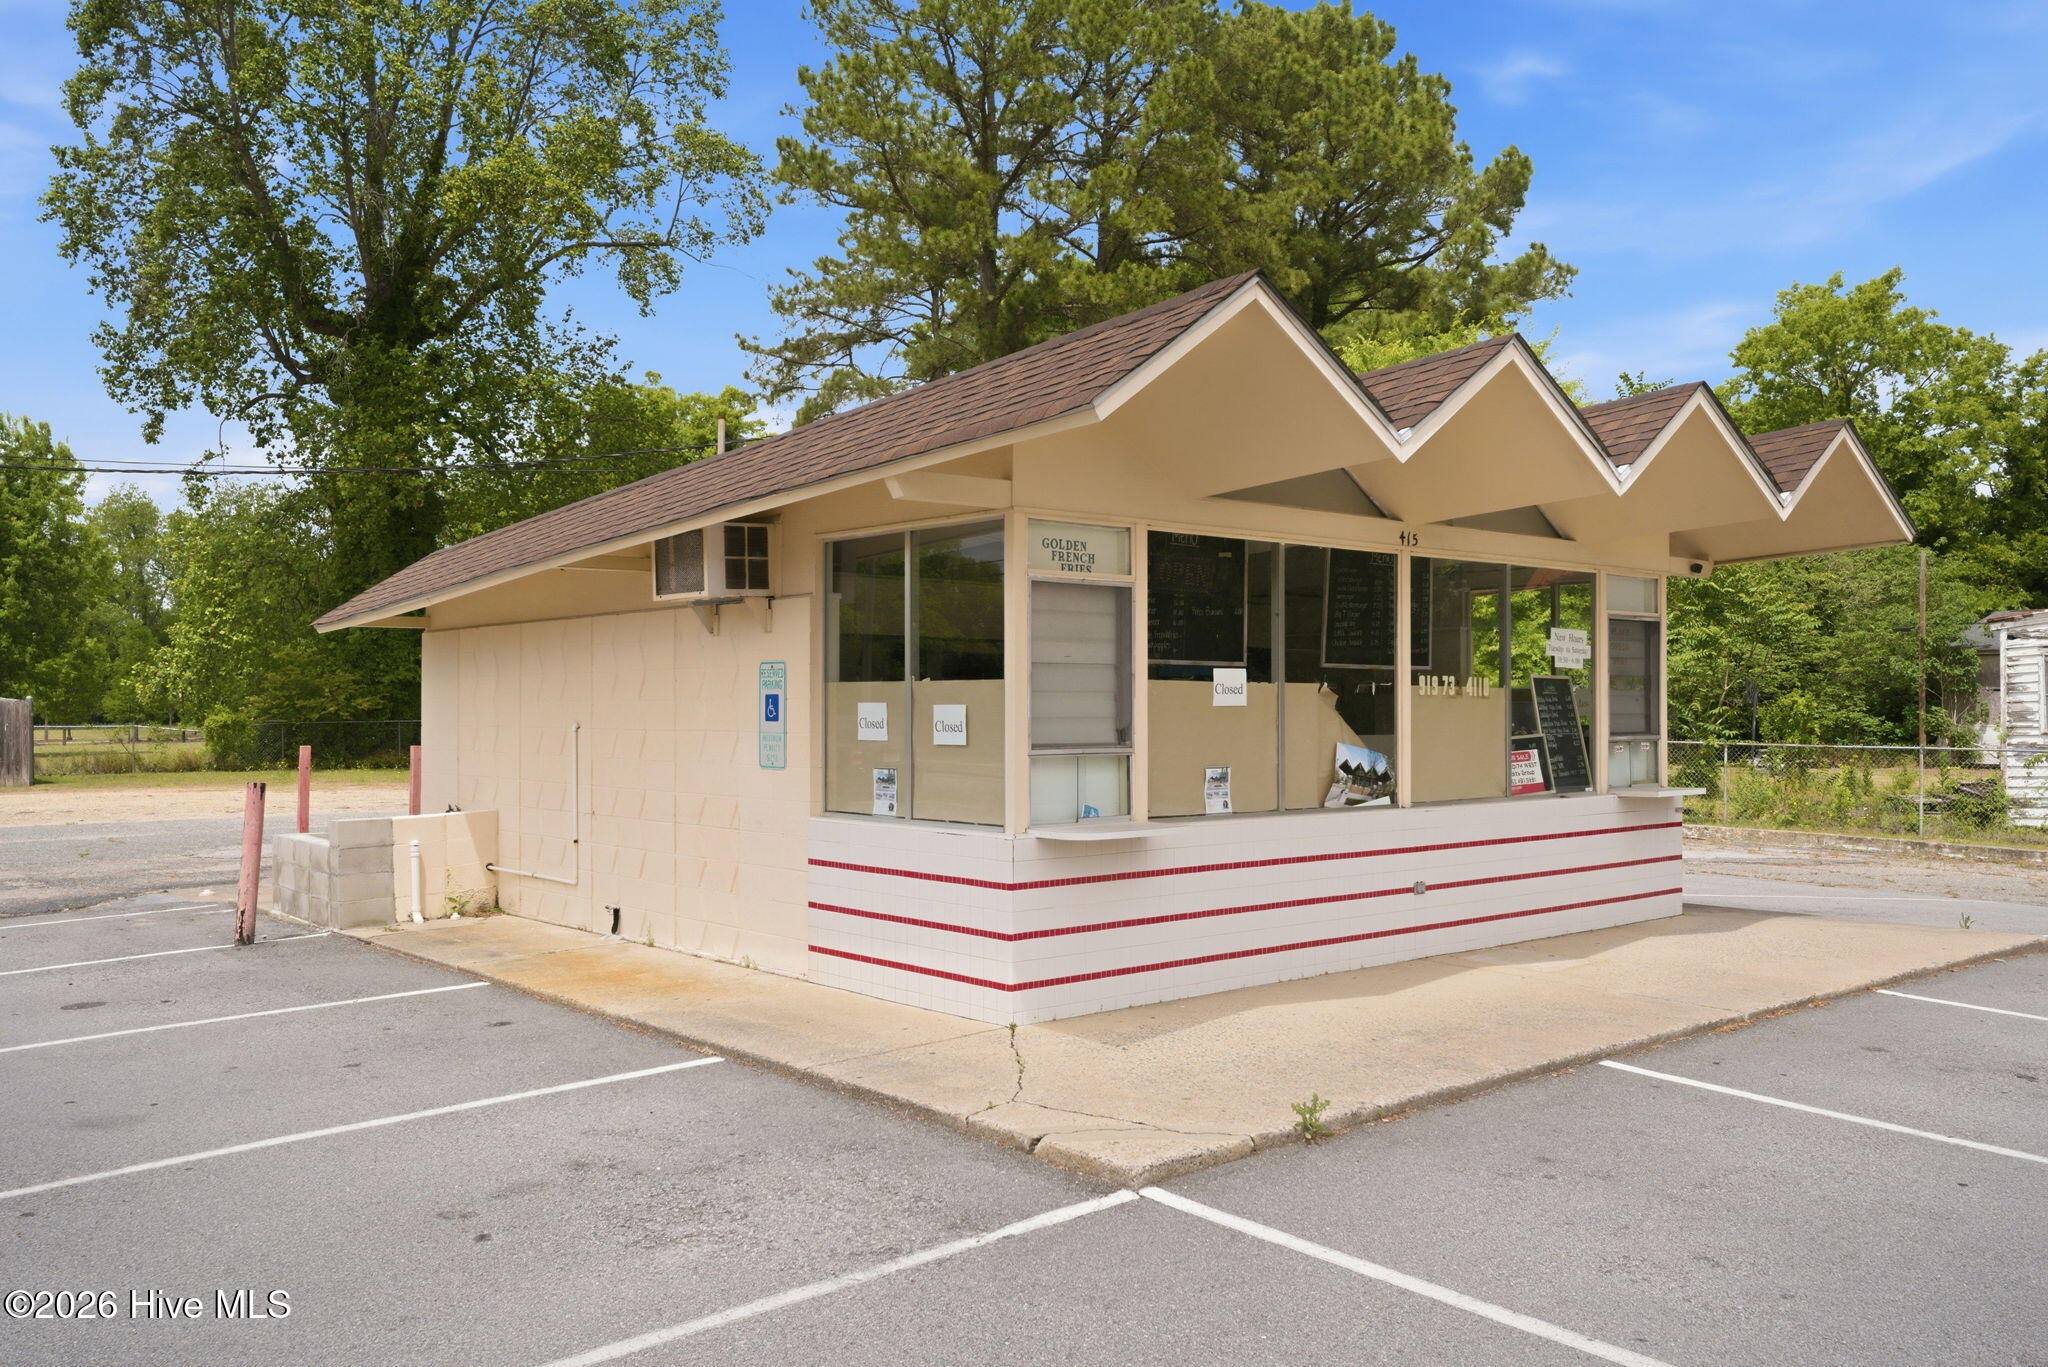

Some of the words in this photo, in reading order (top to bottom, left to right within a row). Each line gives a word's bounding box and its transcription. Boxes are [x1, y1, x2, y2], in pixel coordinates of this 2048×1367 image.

[1041, 536, 1087, 552] GOLDEN
[1399, 530, 1419, 547] 415
[1051, 550, 1096, 564] FRENCH
[1214, 682, 1244, 695] Closed
[859, 717, 885, 729] Closed
[934, 720, 964, 733] Closed
